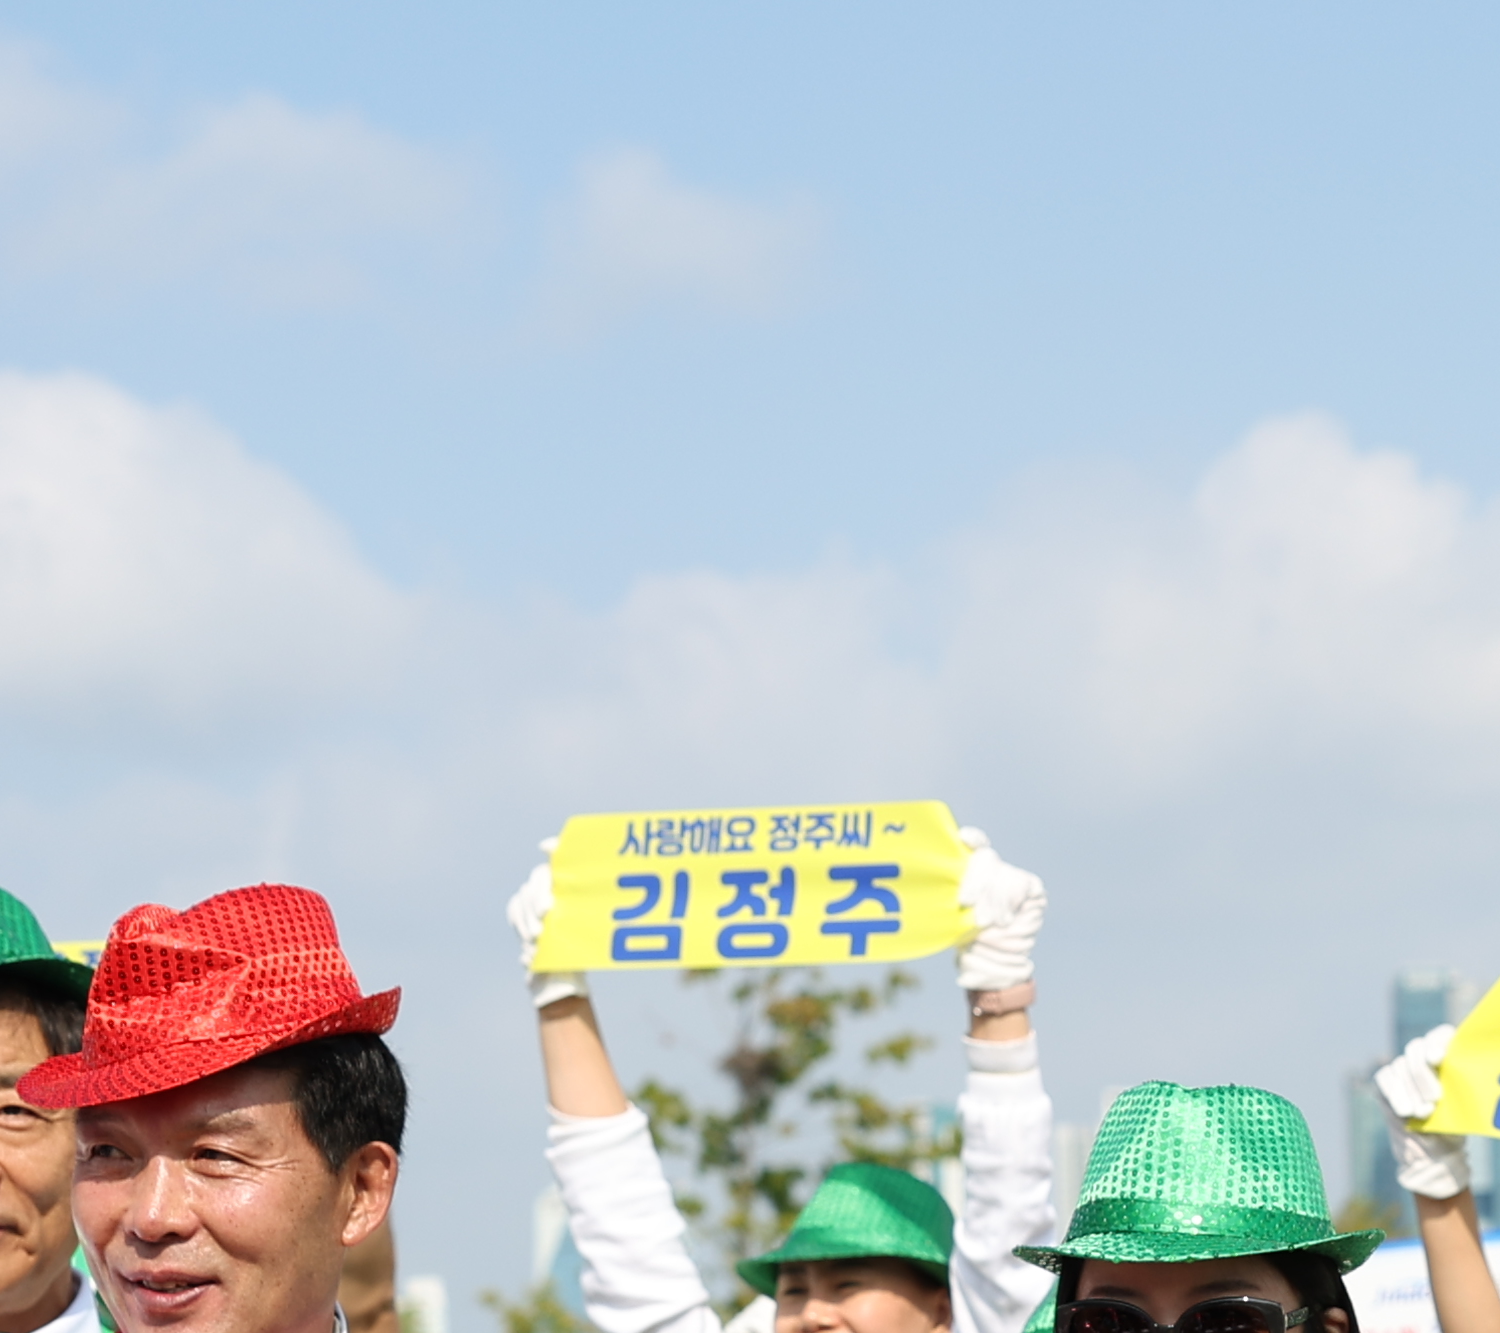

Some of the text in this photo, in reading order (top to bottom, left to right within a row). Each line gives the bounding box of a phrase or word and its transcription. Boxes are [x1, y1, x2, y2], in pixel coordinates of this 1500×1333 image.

[619, 815, 756, 857] 사랑해요
[768, 810, 872, 851] 정주씨
[610, 863, 902, 962] 김정주
